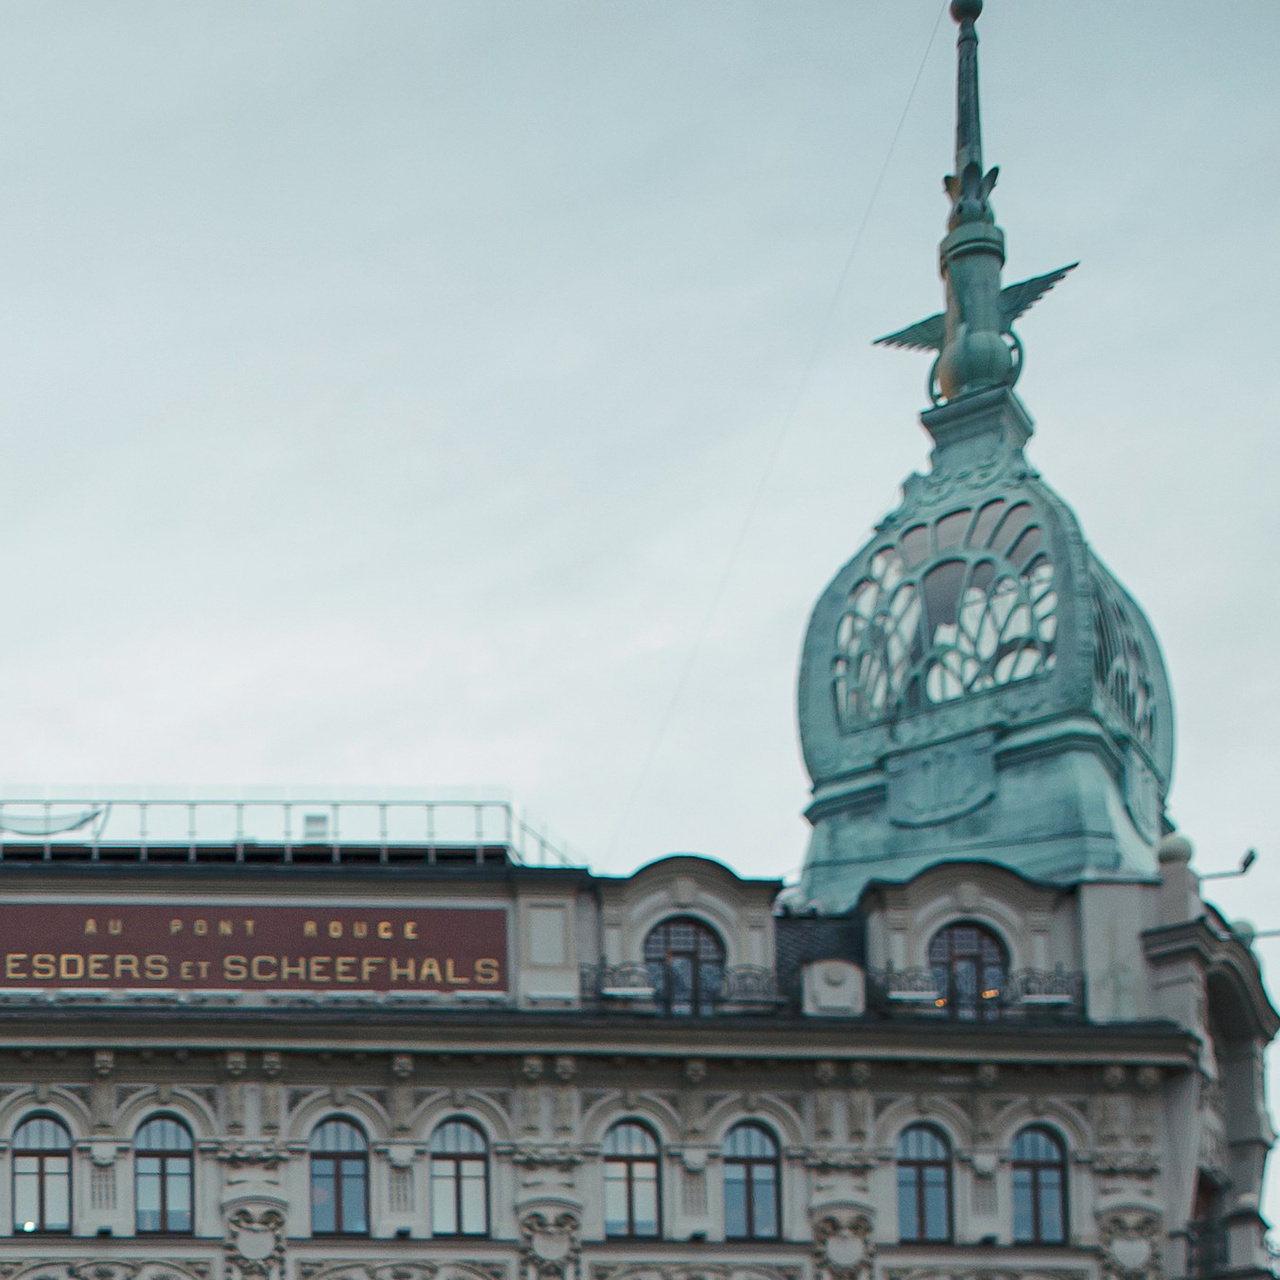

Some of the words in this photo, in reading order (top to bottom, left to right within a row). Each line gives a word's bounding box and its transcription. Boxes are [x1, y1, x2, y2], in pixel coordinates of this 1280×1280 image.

[84, 919, 123, 935] AU
[170, 919, 257, 936] PONT
[304, 920, 420, 939] ROUGE
[5, 953, 170, 980] ESDERS
[180, 961, 210, 980] ET
[224, 954, 500, 985] SCHEEFHALS
